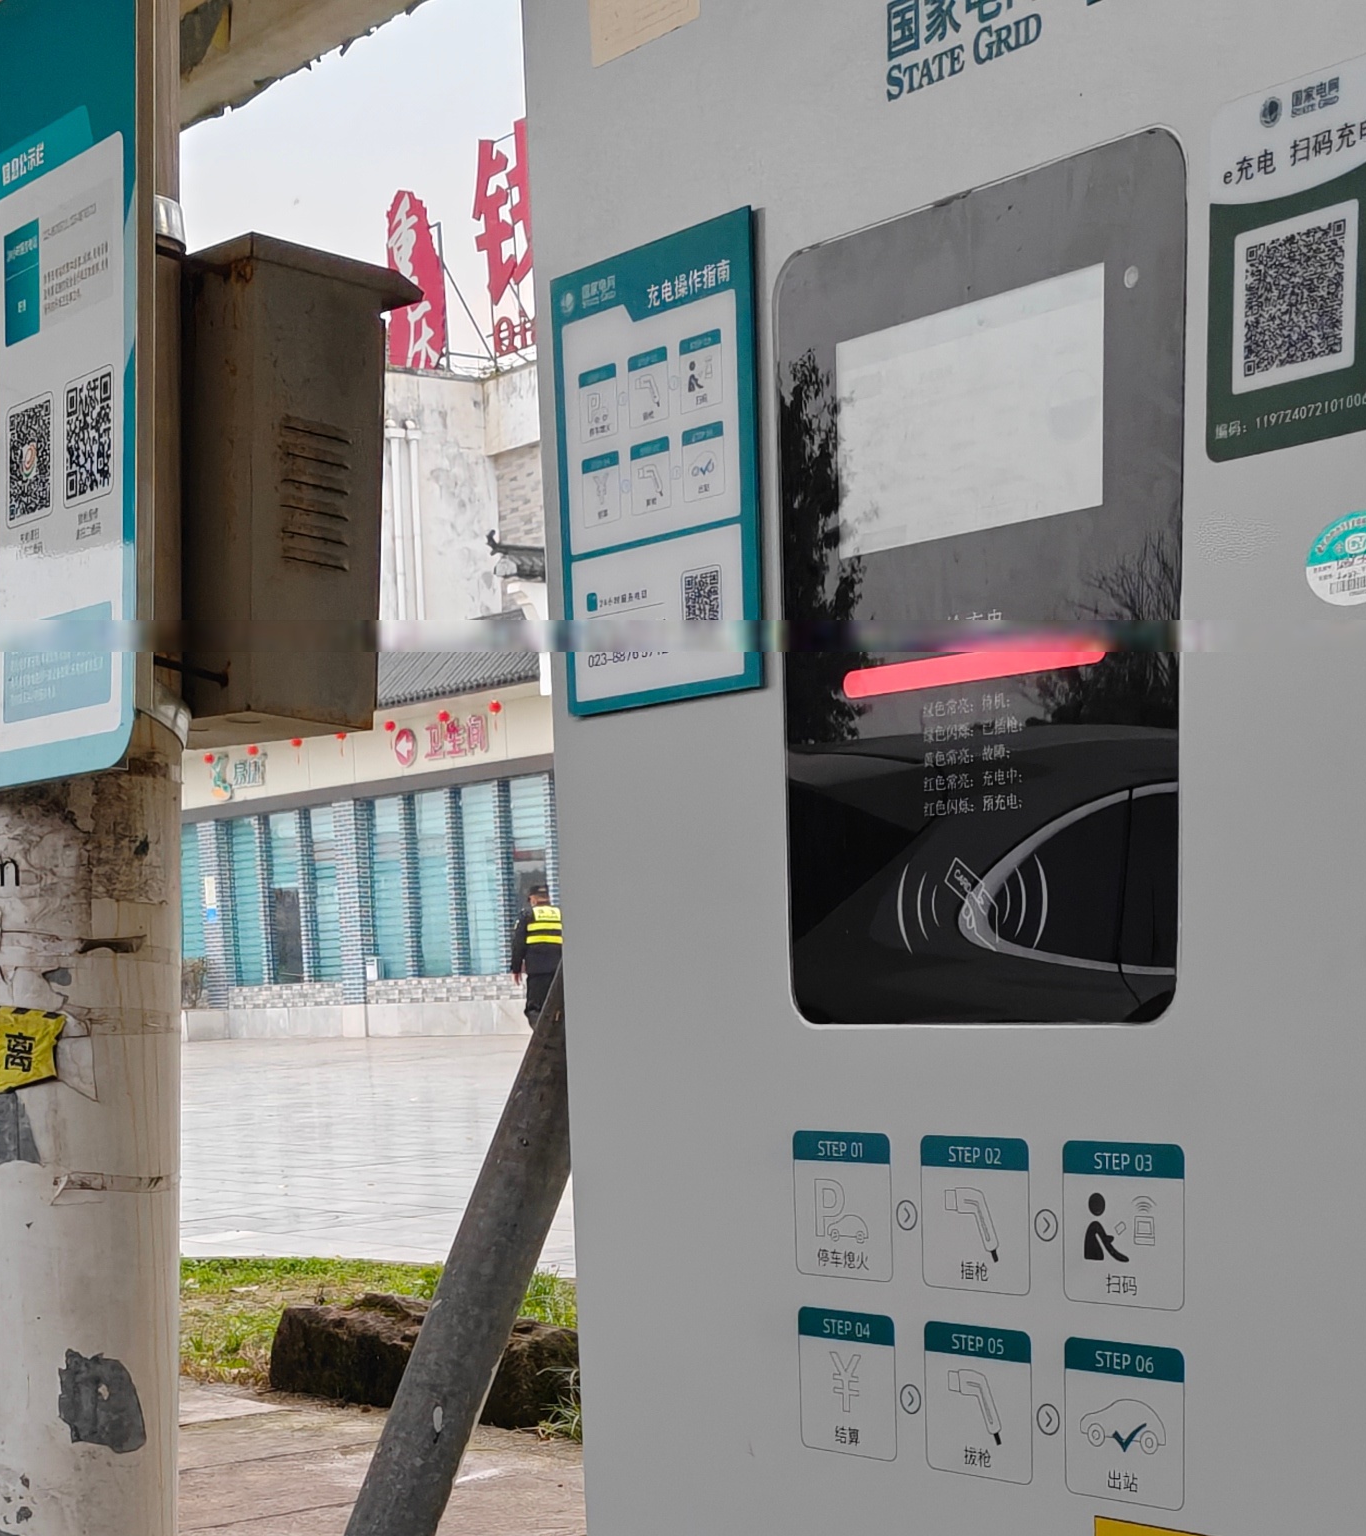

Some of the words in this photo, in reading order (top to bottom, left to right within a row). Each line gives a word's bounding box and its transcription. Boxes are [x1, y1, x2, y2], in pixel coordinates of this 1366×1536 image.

[887, 0, 1033, 61] 国家
[886, 44, 965, 102] STATE
[973, 13, 1043, 65] GRID
[1292, 76, 1340, 107] 国家电网
[1223, 149, 1277, 186] e充电
[646, 259, 732, 309] 充电操作指南
[424, 714, 488, 761] 卫生间
[817, 1140, 847, 1158] STEP
[849, 1141, 864, 1158] 01
[947, 1146, 981, 1164] STEP
[984, 1147, 1002, 1165] 02
[1093, 1153, 1130, 1171] STEP
[1134, 1154, 1153, 1172] 03
[817, 1248, 870, 1271] 停车熄火
[960, 1261, 989, 1282] 插枪
[1105, 1274, 1138, 1296] 扫码
[822, 1318, 852, 1337] STEP
[854, 1321, 871, 1339] 04
[951, 1333, 984, 1353] STEP
[987, 1337, 1005, 1355] 05
[1094, 1350, 1131, 1370] STEP
[1135, 1355, 1155, 1375] 06
[834, 1425, 861, 1447] 结算
[963, 1446, 992, 1468] 拔枪
[1107, 1469, 1139, 1493] 出站
